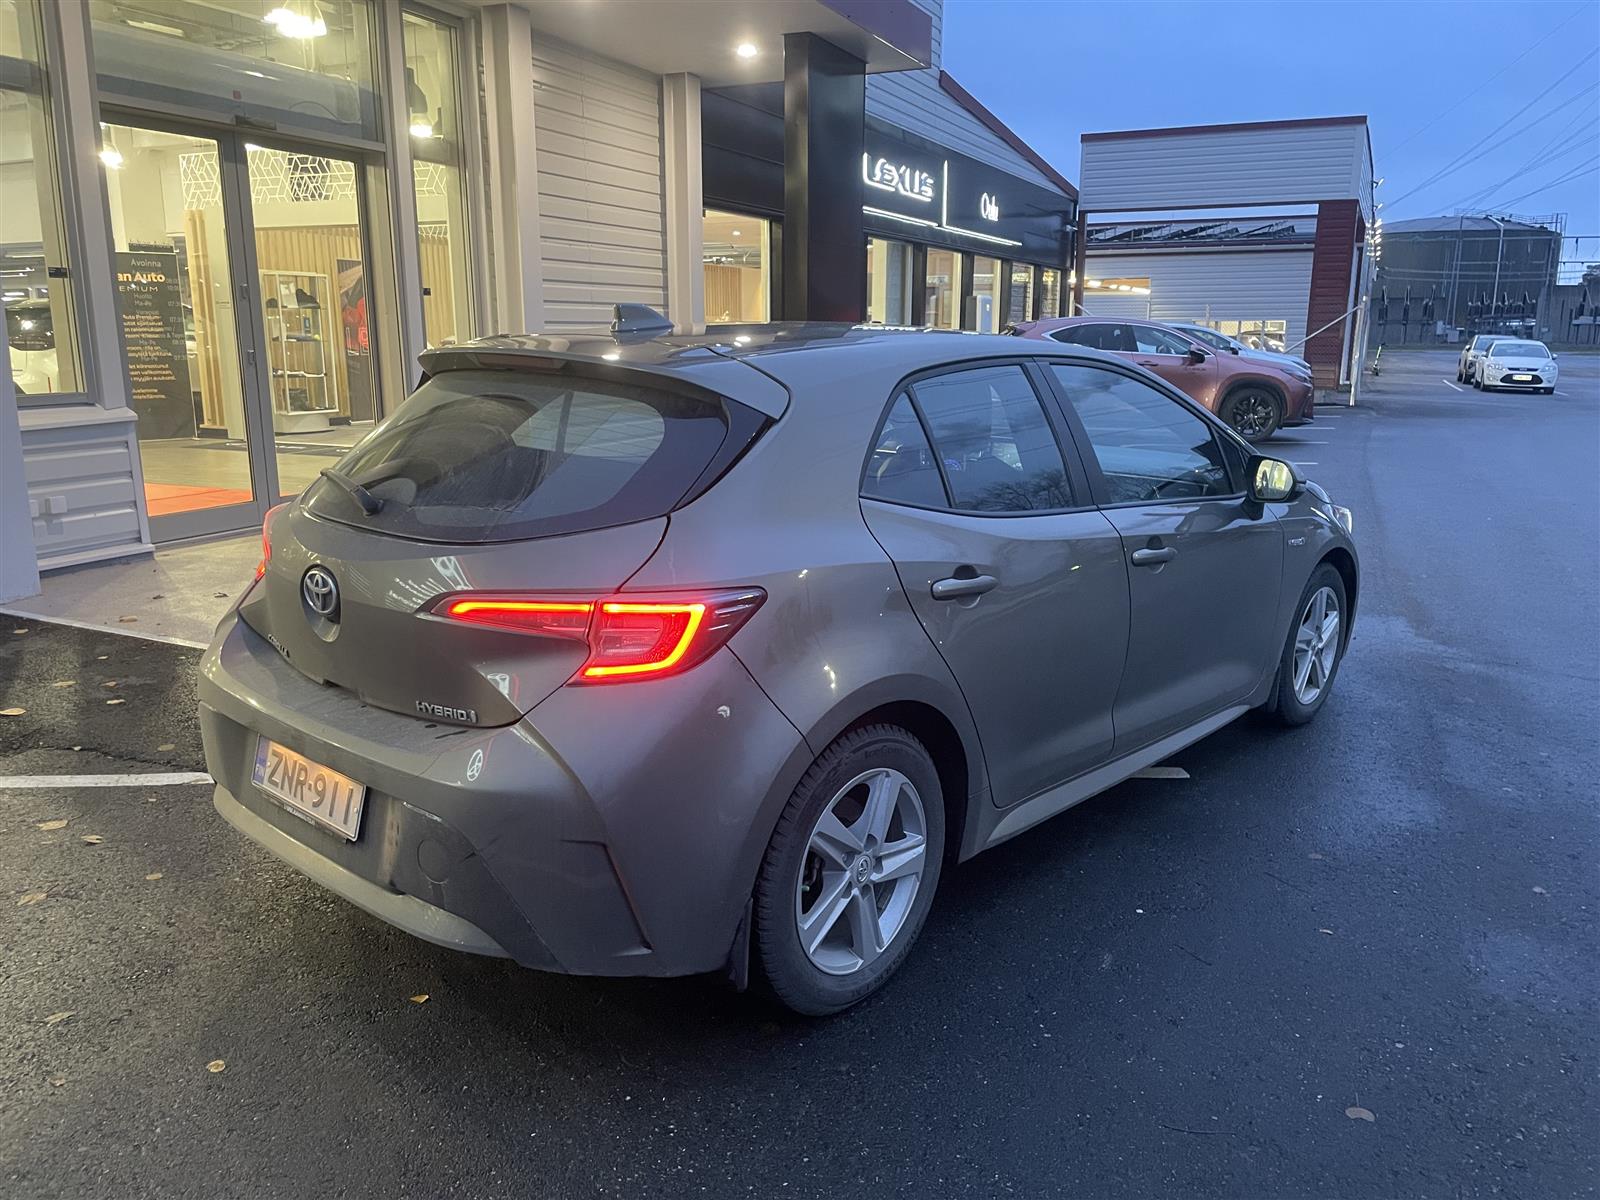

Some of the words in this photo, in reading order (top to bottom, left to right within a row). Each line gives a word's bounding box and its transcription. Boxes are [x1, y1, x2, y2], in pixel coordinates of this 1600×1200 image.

[862, 151, 935, 202] LEXUS
[131, 258, 161, 267] Avoinna
[134, 272, 165, 282] Auto
[415, 700, 467, 721] HYBRID
[267, 748, 354, 826] ZNR-911
